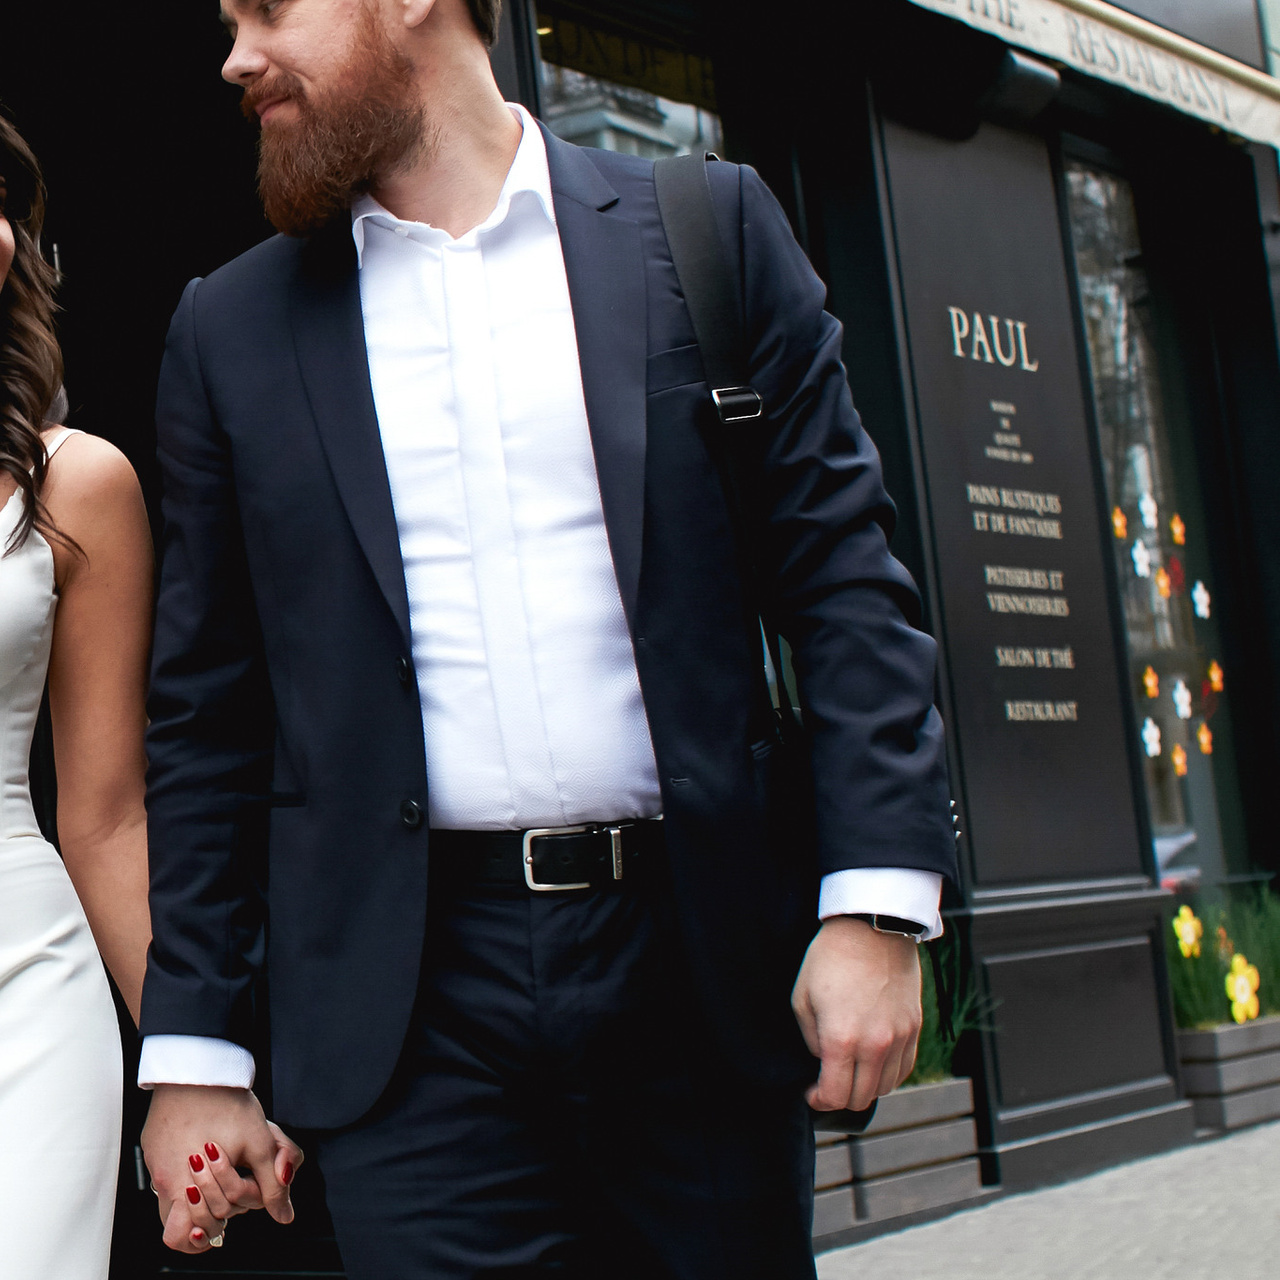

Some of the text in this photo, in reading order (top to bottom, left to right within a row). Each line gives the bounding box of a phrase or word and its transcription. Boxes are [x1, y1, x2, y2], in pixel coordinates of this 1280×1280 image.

[1063, 10, 1234, 121] RESTAURANT
[947, 306, 1039, 372] PAUL
[973, 510, 989, 531] ET
[989, 512, 1008, 534] DE
[995, 646, 1035, 667] SALON
